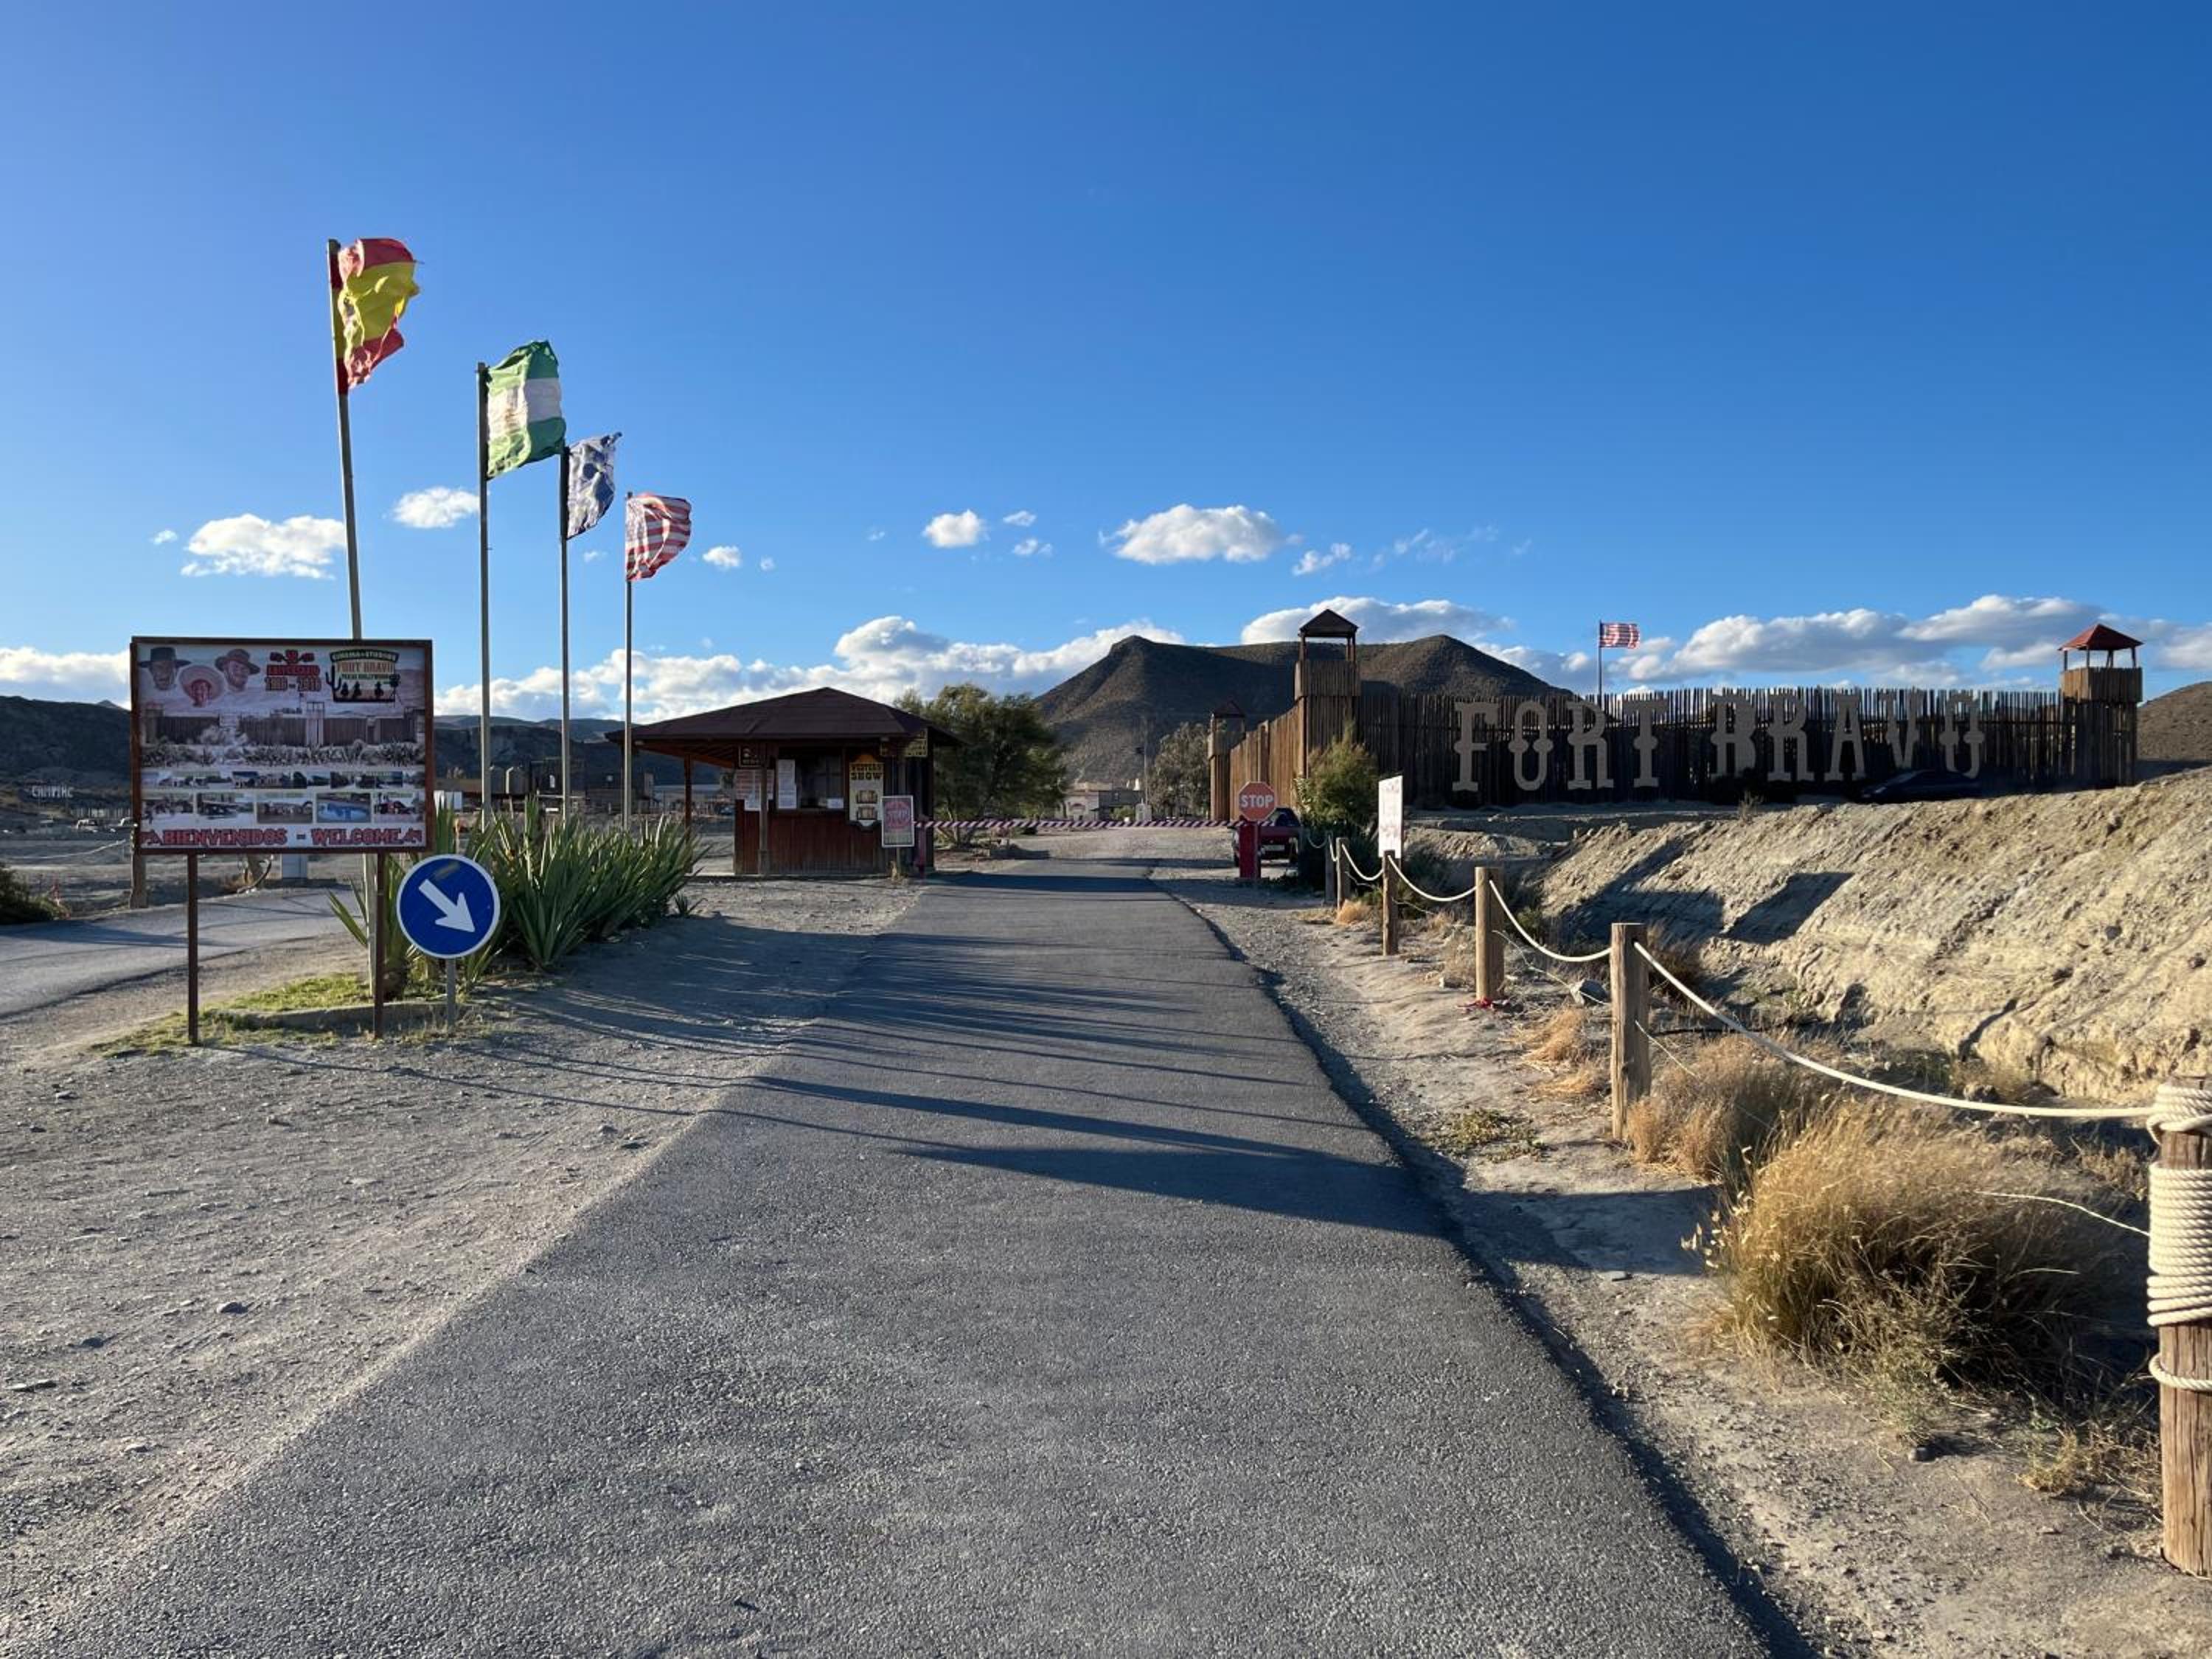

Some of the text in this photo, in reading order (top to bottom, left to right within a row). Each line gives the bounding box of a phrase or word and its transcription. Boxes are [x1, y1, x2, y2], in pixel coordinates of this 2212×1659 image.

[1452, 690, 1985, 792] FORT BRAVO
[1240, 794, 1274, 808] STOP
[163, 827, 288, 847] BIENVENIDOS
[311, 827, 401, 846] WELCOME
